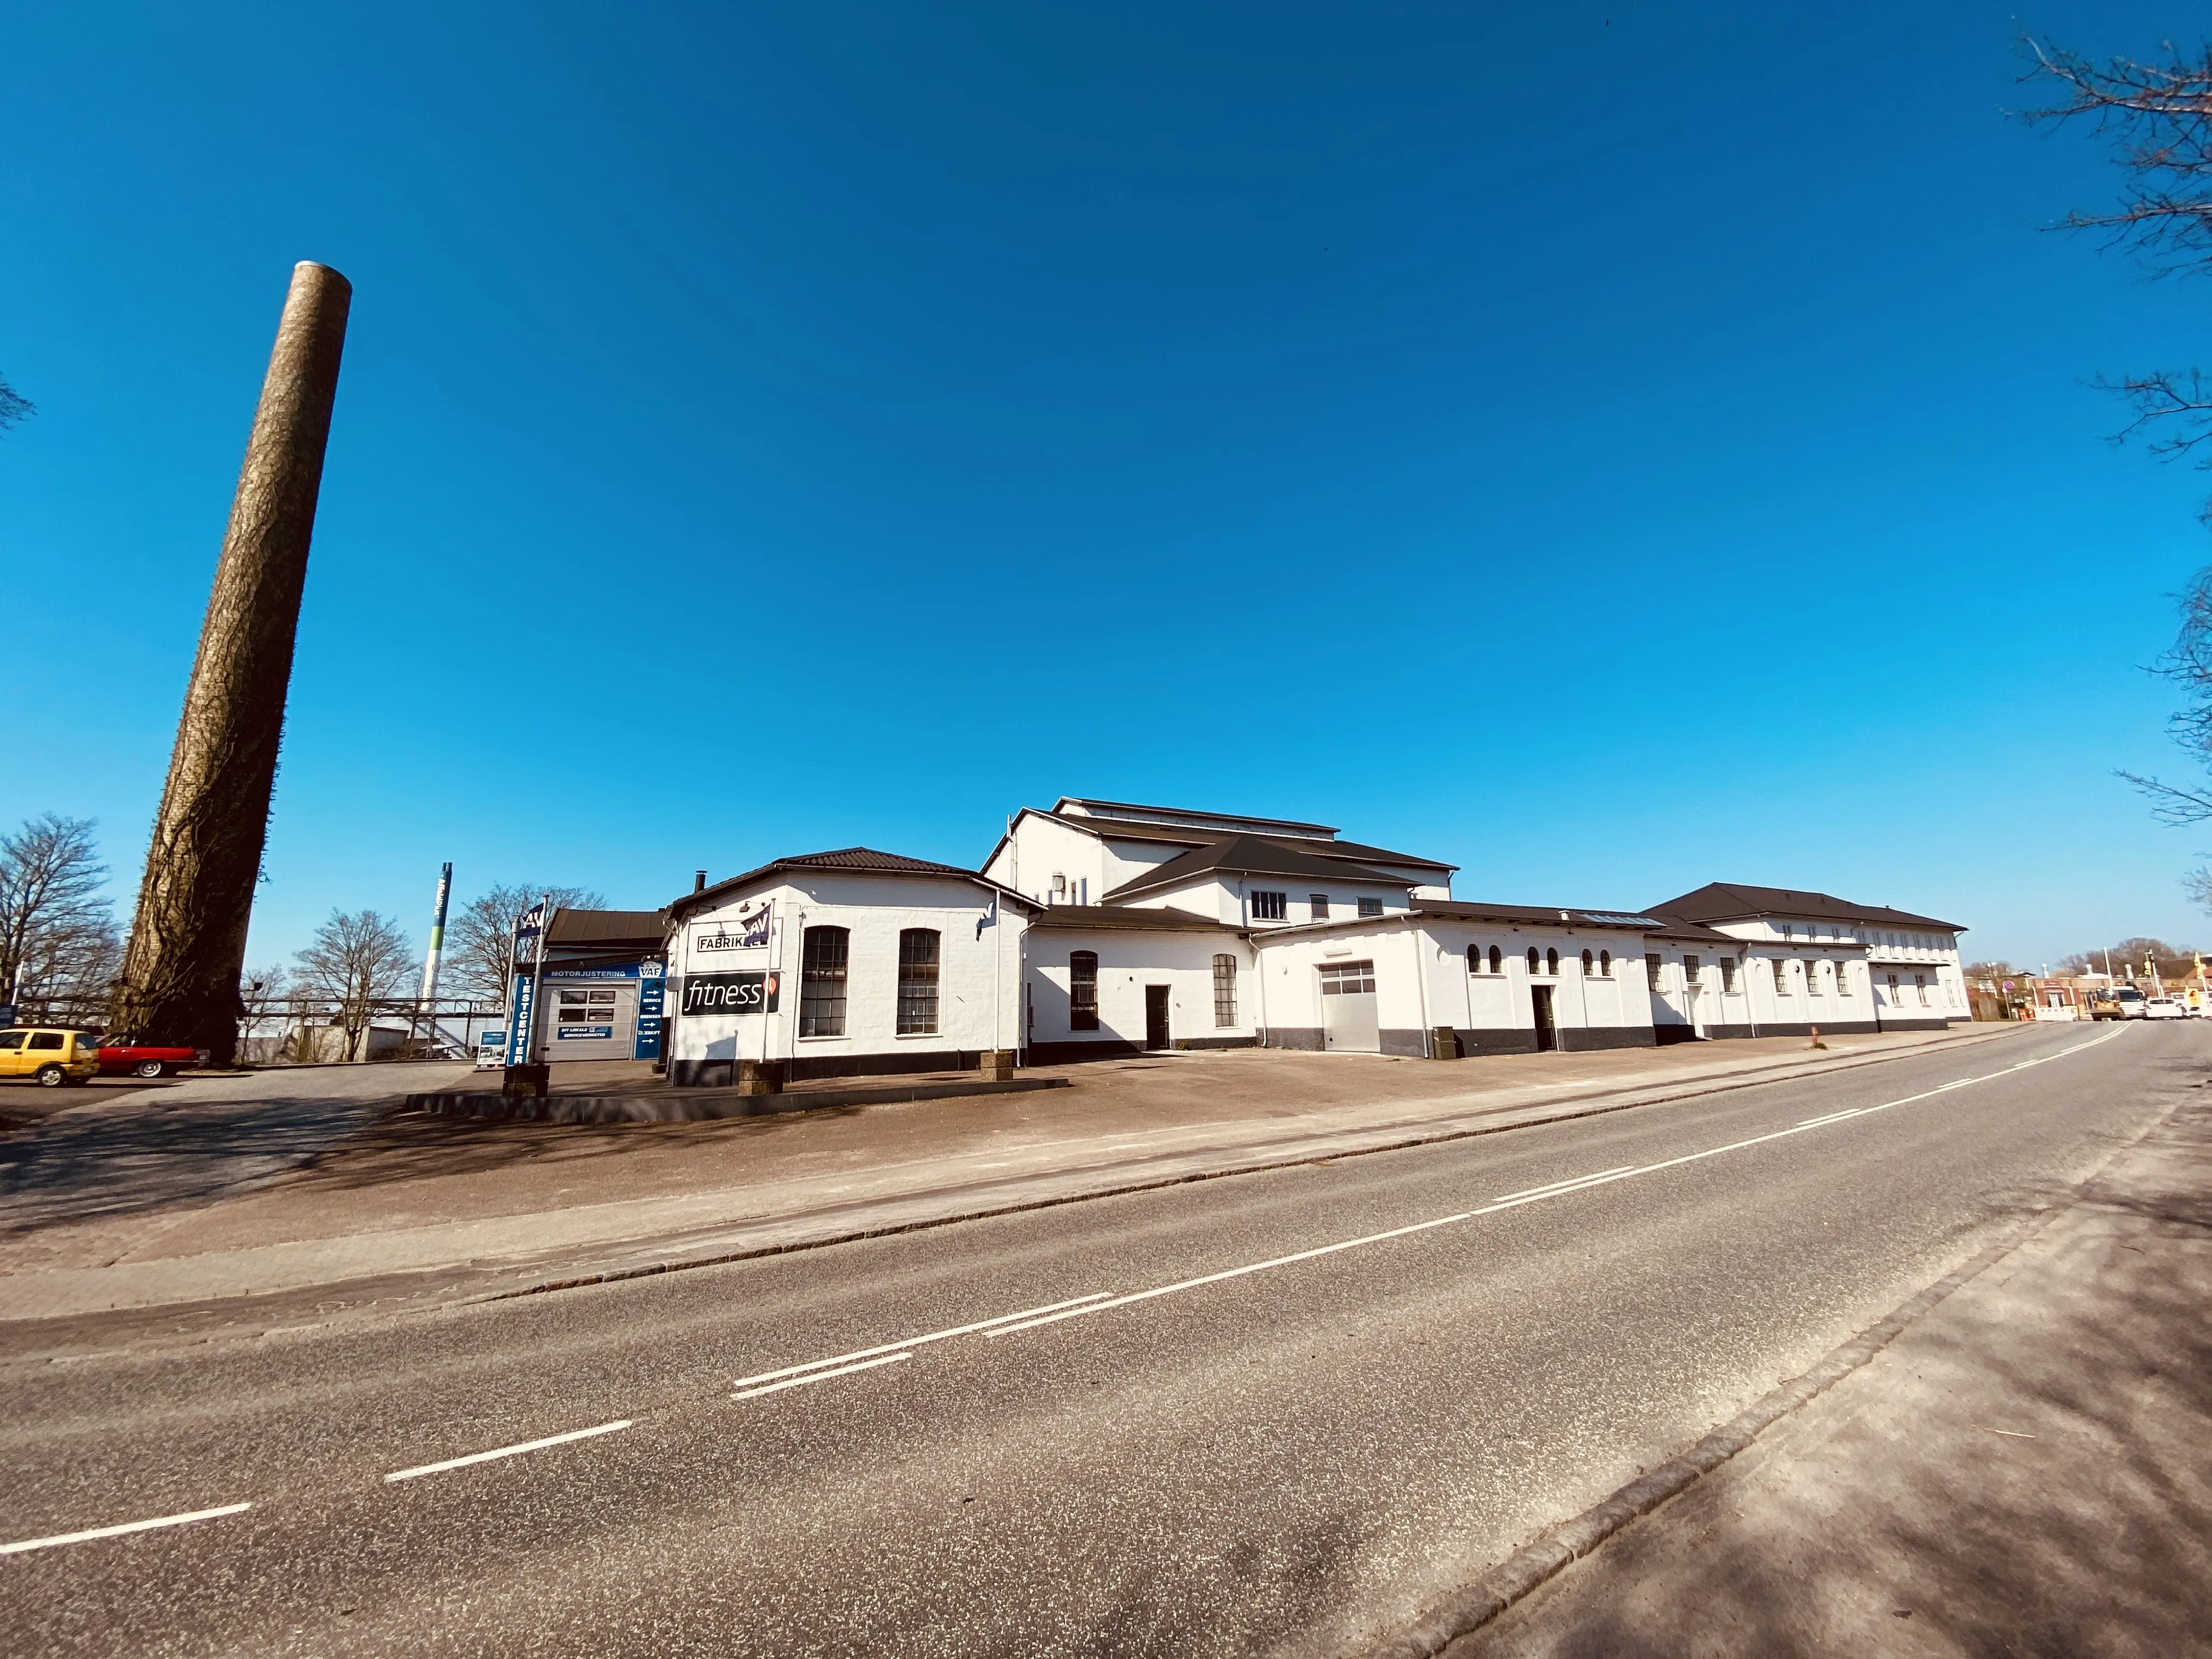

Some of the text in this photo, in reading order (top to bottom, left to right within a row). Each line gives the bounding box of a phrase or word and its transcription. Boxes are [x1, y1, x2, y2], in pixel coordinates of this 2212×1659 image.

[700, 937, 768, 949] FABRIK
[684, 980, 762, 1012] fitness
[514, 977, 531, 1063] TESTCENTER
